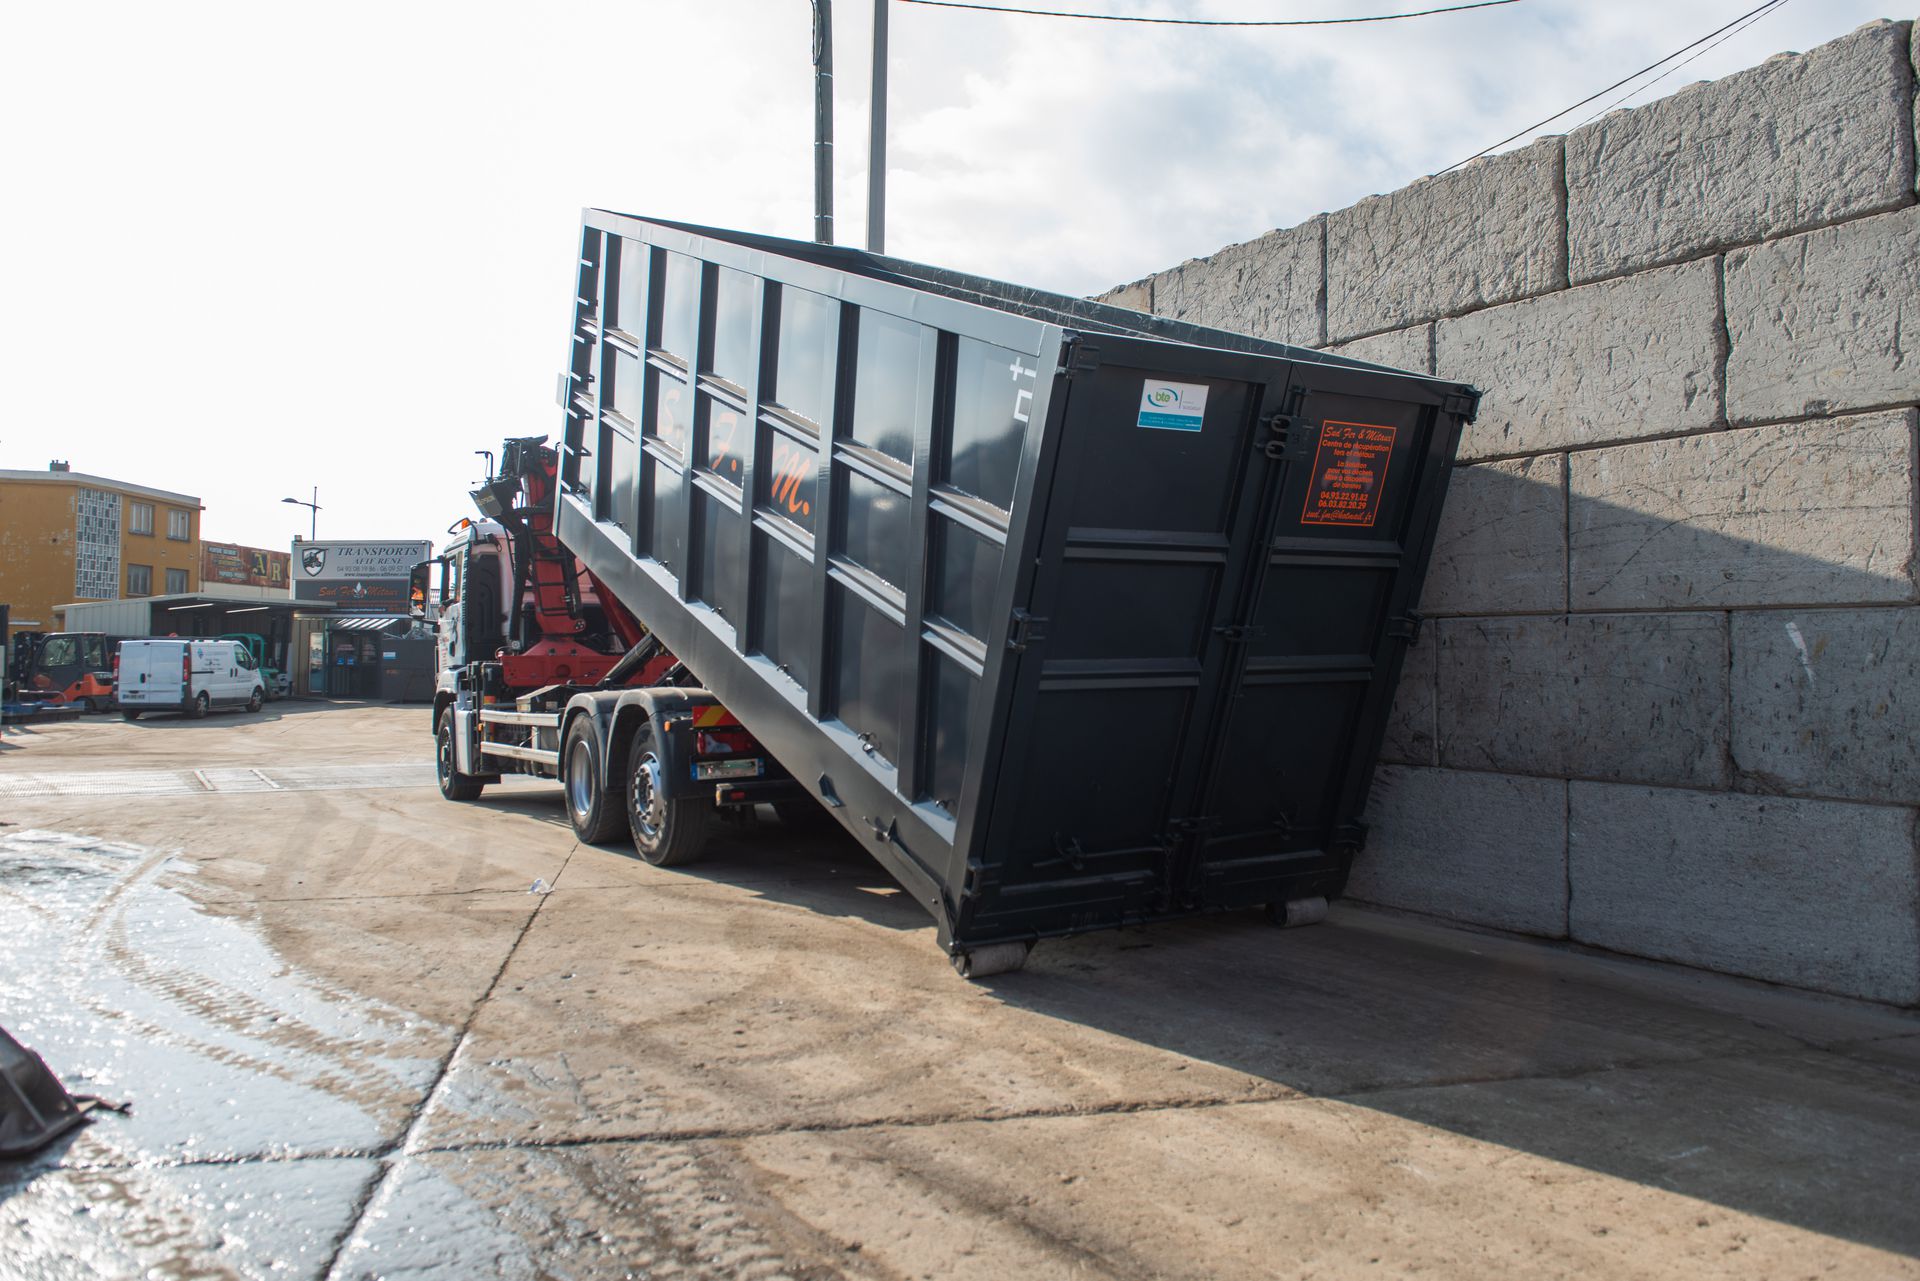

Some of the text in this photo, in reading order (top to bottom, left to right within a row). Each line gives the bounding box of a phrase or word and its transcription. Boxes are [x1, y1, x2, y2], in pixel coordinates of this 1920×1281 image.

[1155, 391, 1171, 403] bte
[1324, 426, 1342, 438] Sud
[1342, 428, 1356, 440] Fer
[1358, 429, 1366, 440] &
[1322, 440, 1390, 452] Centre de récupération
[1353, 450, 1375, 459] métaux
[1327, 467, 1340, 476] pour
[1344, 475, 1374, 484] disposition
[337, 547, 419, 556] TRANSPORTS
[319, 586, 337, 597] Sud
